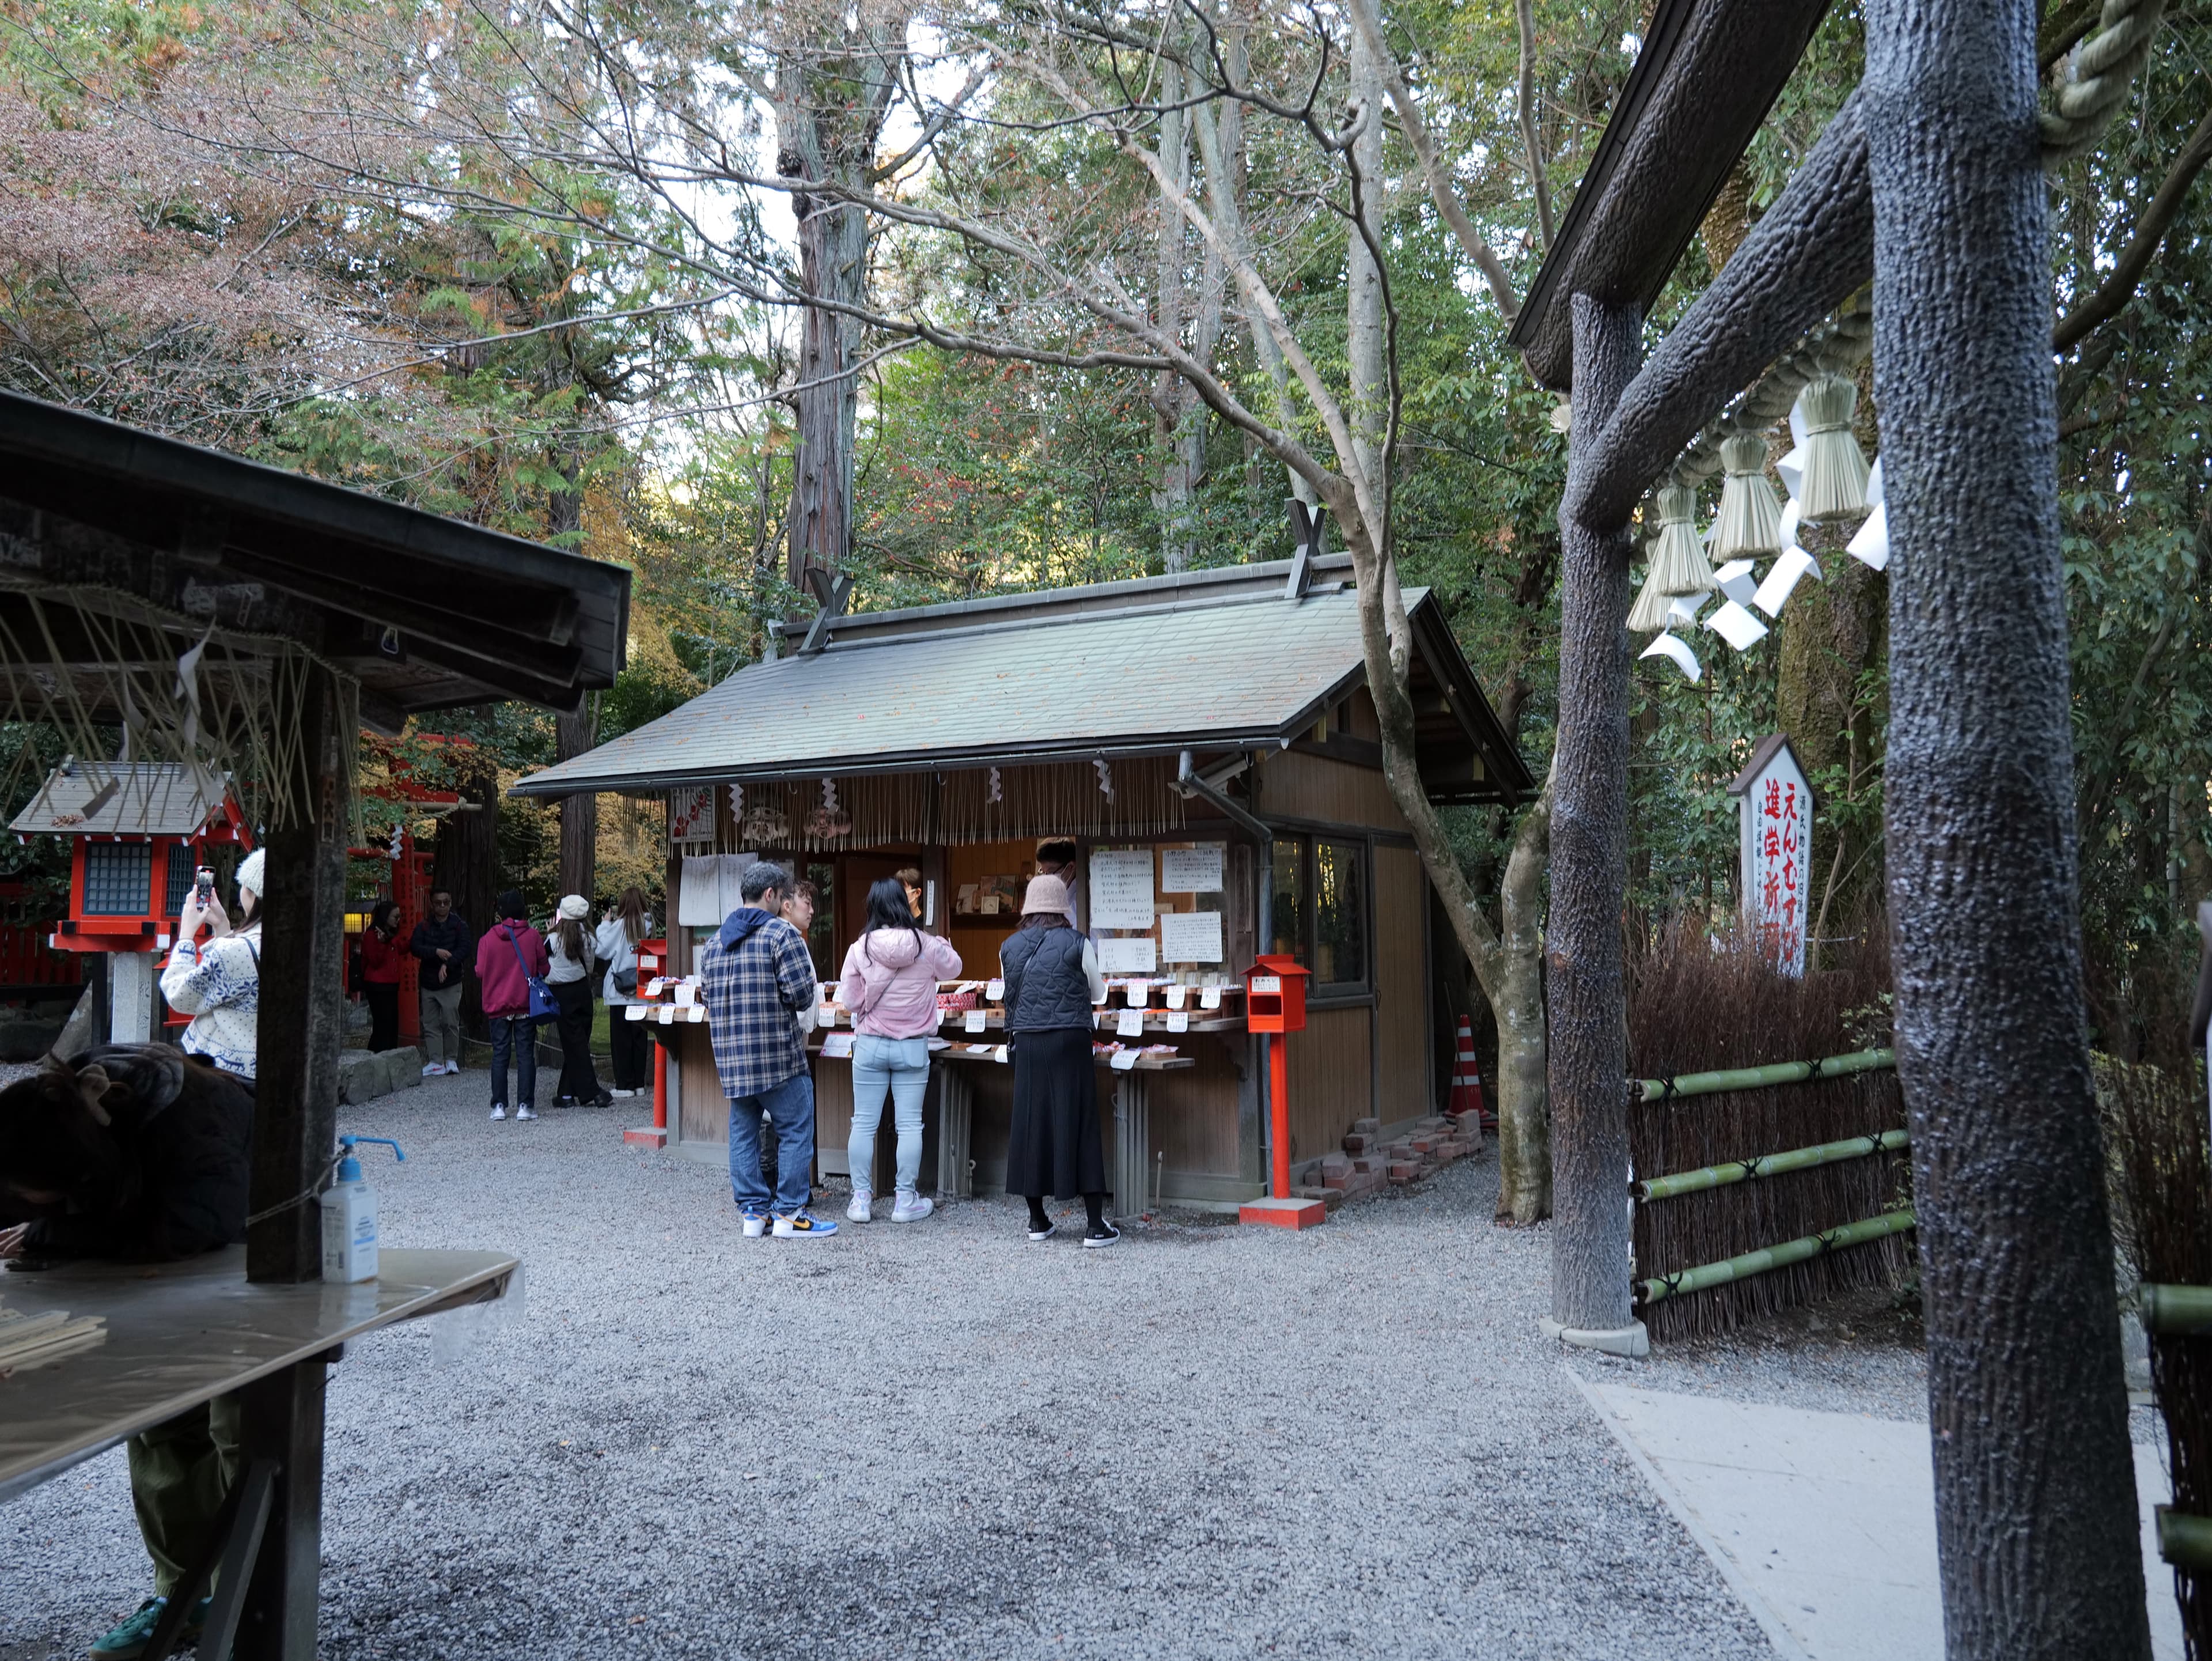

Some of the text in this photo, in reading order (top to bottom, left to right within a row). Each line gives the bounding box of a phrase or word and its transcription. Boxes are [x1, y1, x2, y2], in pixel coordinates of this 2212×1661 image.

[1782, 781, 1798, 962] えんむすび
